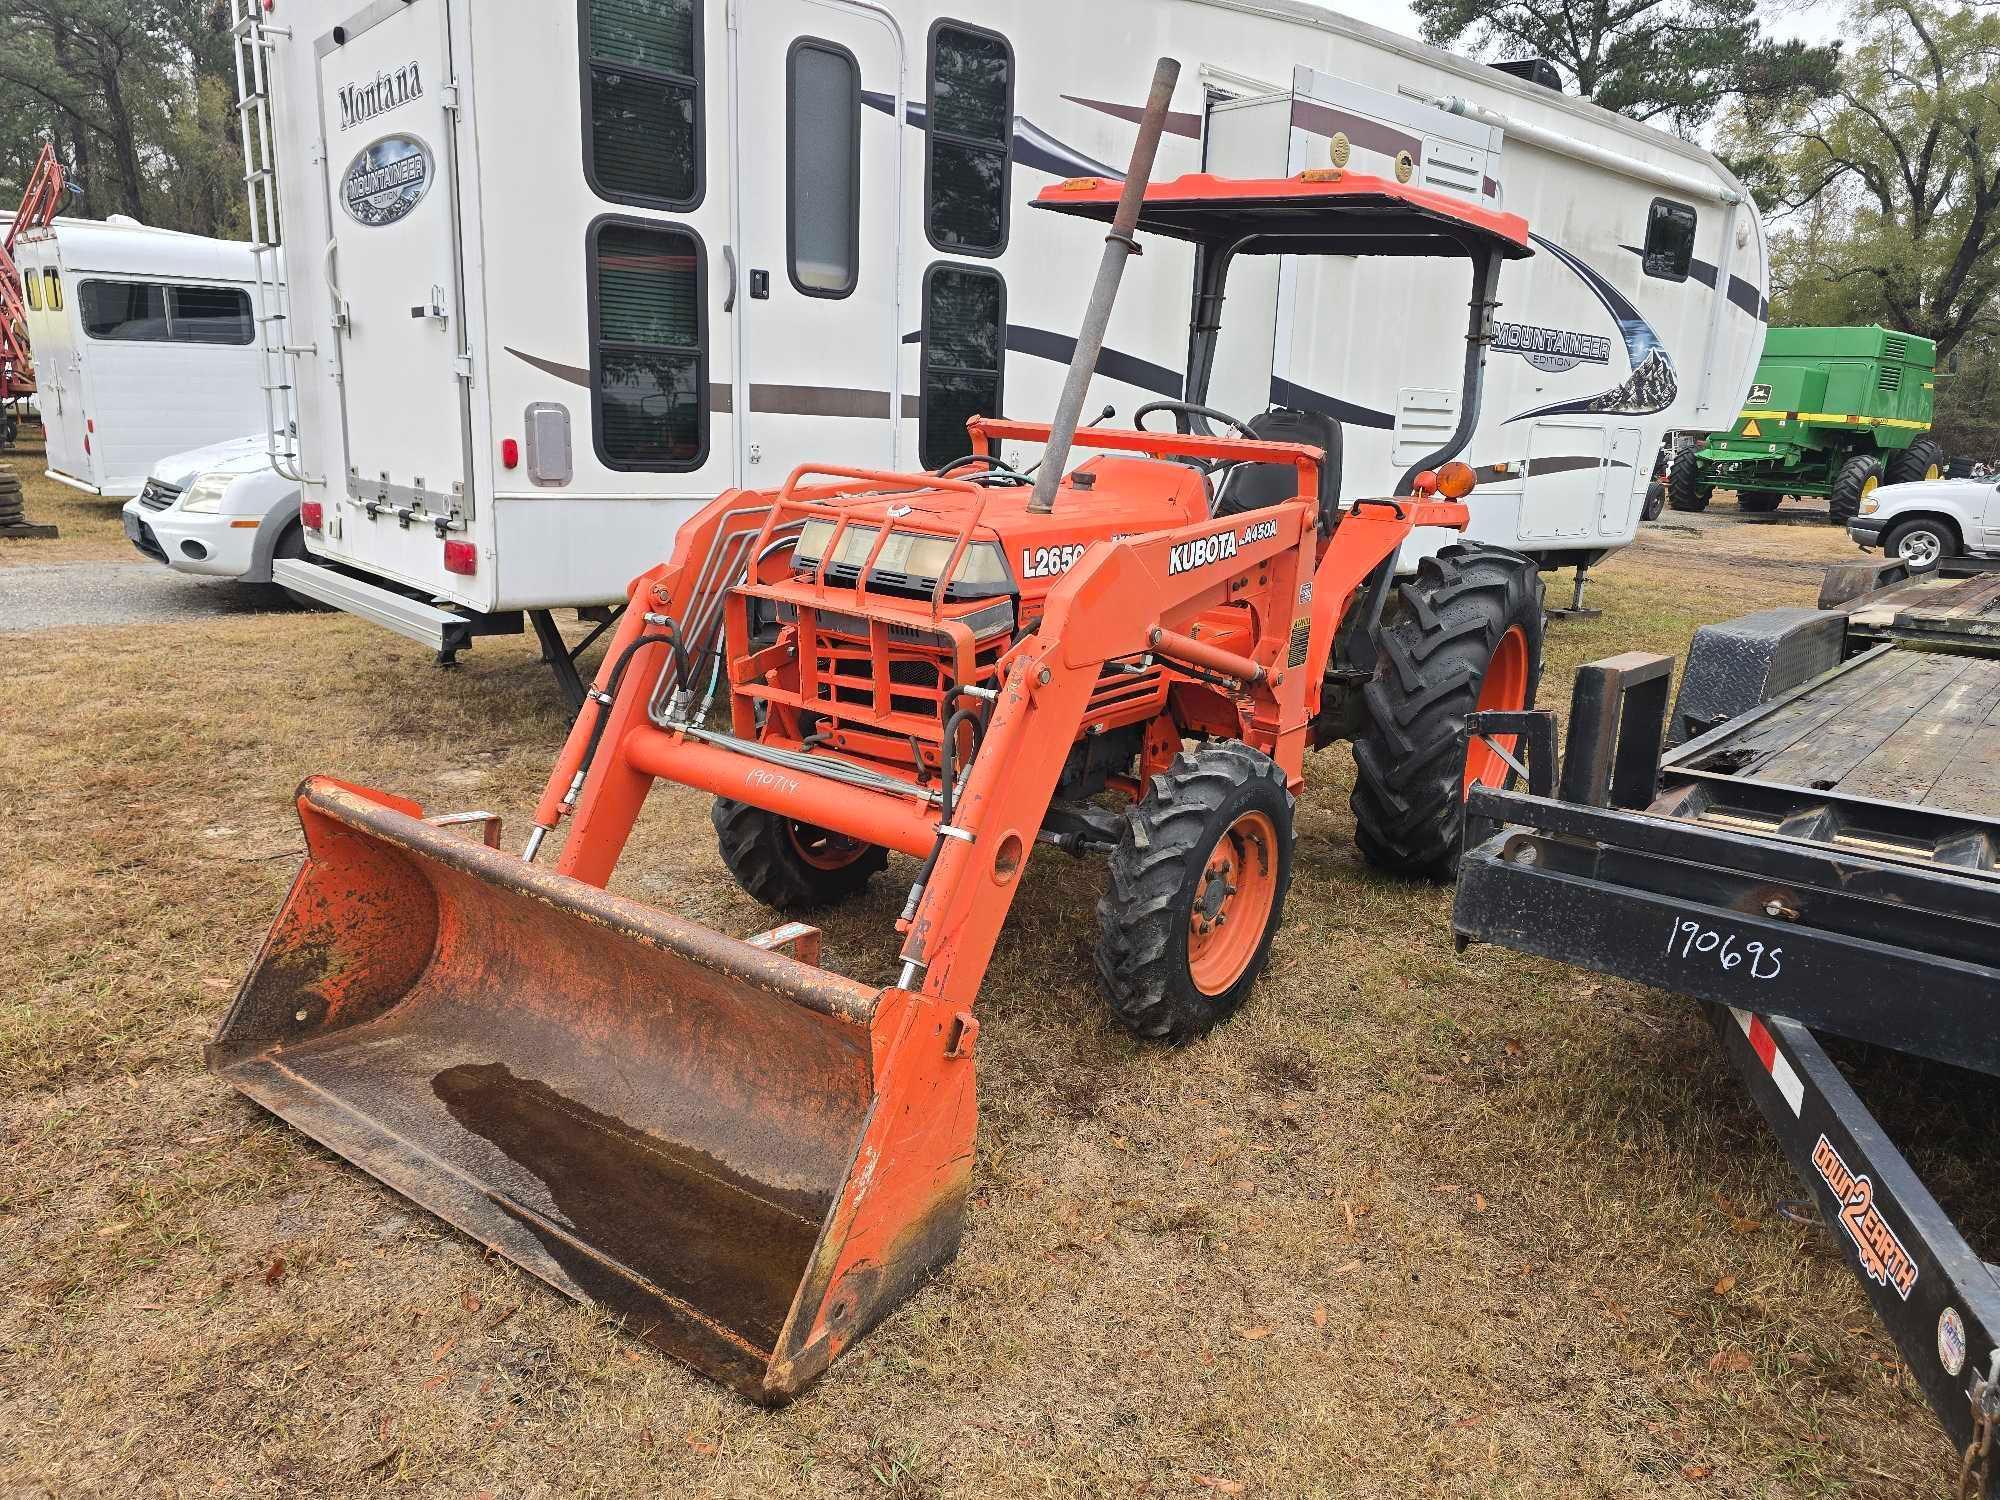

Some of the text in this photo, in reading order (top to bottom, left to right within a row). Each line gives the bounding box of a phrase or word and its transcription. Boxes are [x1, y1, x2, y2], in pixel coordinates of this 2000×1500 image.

[338, 60, 424, 131] Montana
[349, 155, 425, 201] MOUNTAINEER
[373, 191, 398, 205] EDITION
[1492, 321, 1611, 359] MOUNTAINEER
[1532, 354, 1571, 368] EDITION
[1168, 530, 1237, 576] KUBOTA
[1861, 1208, 1916, 1295] EARTH
